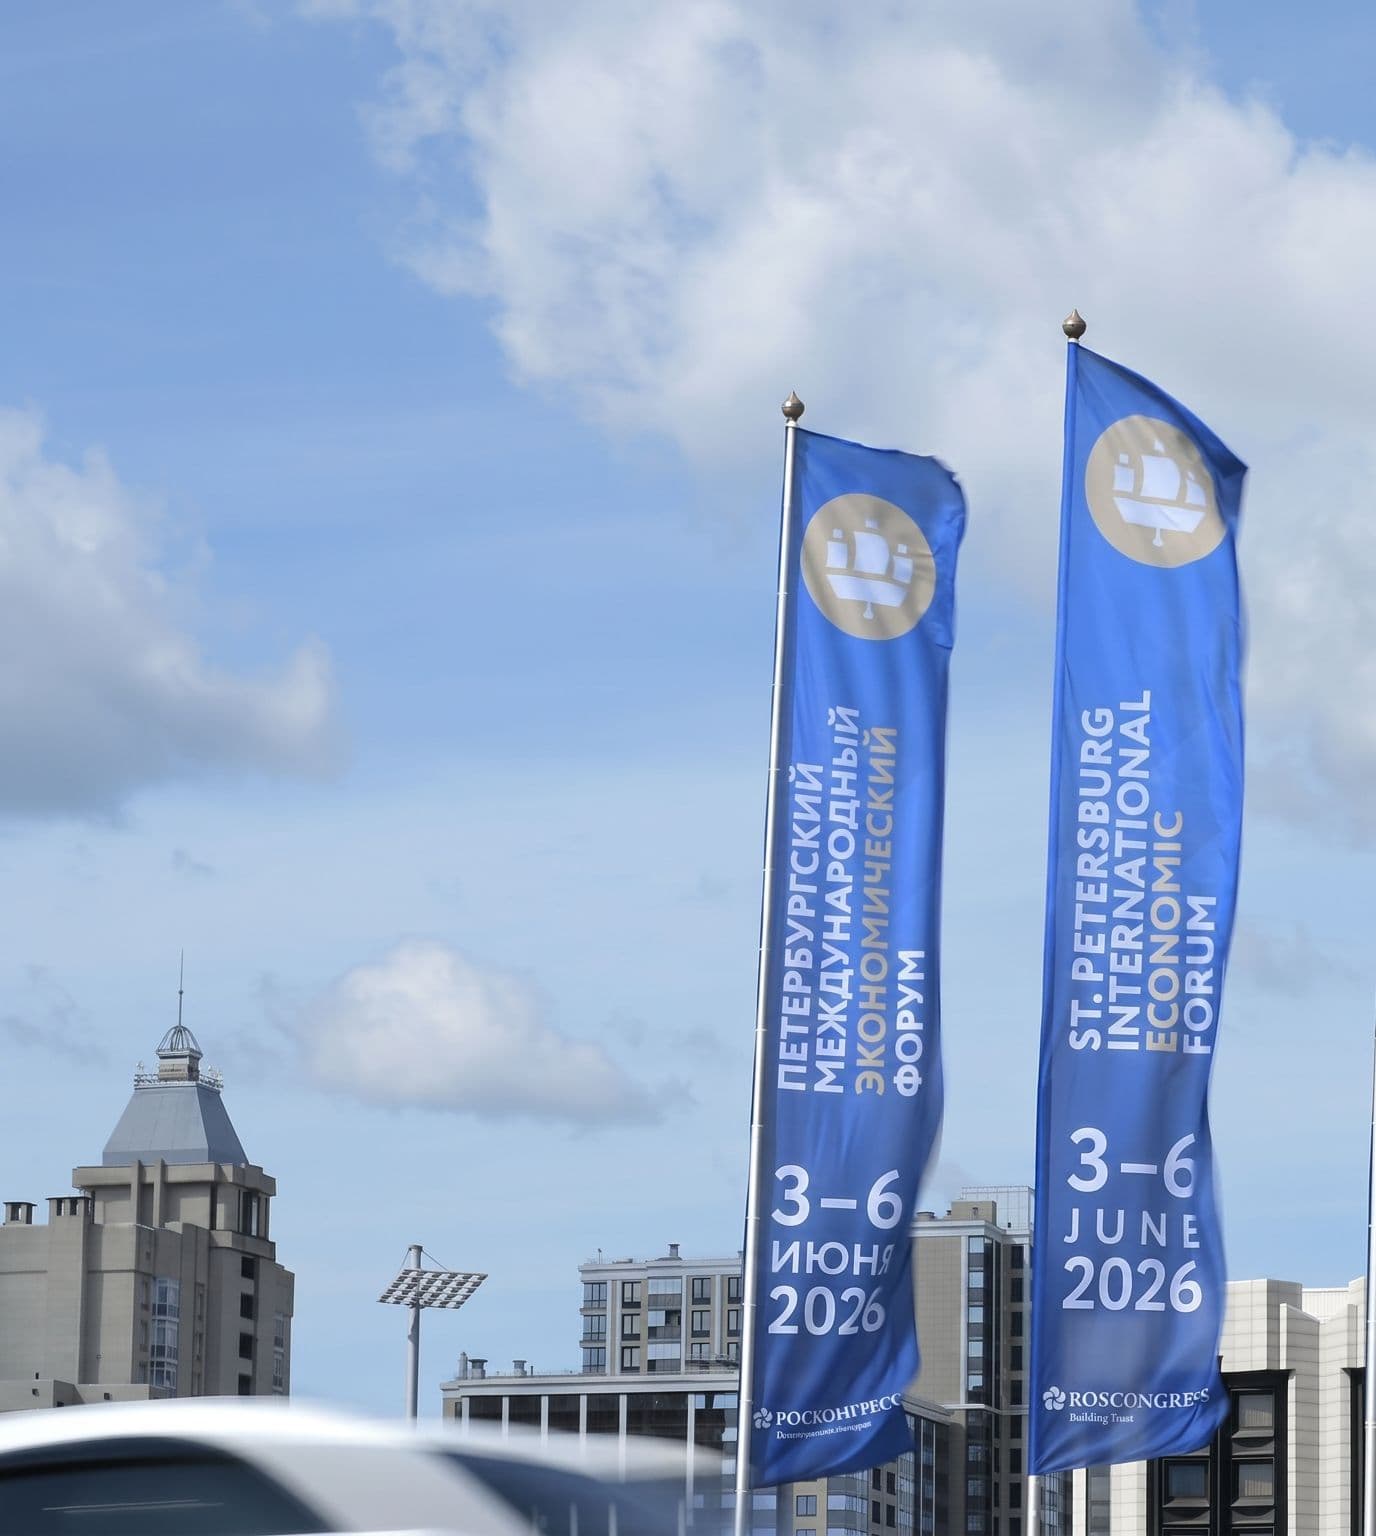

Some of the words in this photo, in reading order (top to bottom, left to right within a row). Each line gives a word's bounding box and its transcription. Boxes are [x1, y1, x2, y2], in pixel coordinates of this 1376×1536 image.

[814, 705, 860, 1094] МЕЖДУНАРОДНЫЙ
[855, 726, 898, 1096] ЭКОНОМИЧЕСКИЙ
[1071, 707, 1114, 982] PETERSBURG
[1107, 690, 1151, 1050] INTERNATIONAL
[778, 763, 824, 1091] ПЕТЕРБУРГСКИЙ
[1145, 810, 1183, 1052] ECONOMIC
[1183, 895, 1216, 1054] FORUM
[893, 950, 925, 1097] ФОРУМ
[1068, 993, 1102, 1051] ST.
[772, 1241, 895, 1276] ИЮНЯ
[1062, 1256, 1202, 1313] 2026
[1063, 1208, 1200, 1248] JUNE
[768, 1286, 885, 1335] 2026
[776, 1393, 903, 1426] РОСКОНГРЕСС
[1069, 1412, 1108, 1425] Building
[1110, 1413, 1135, 1423] Trust
